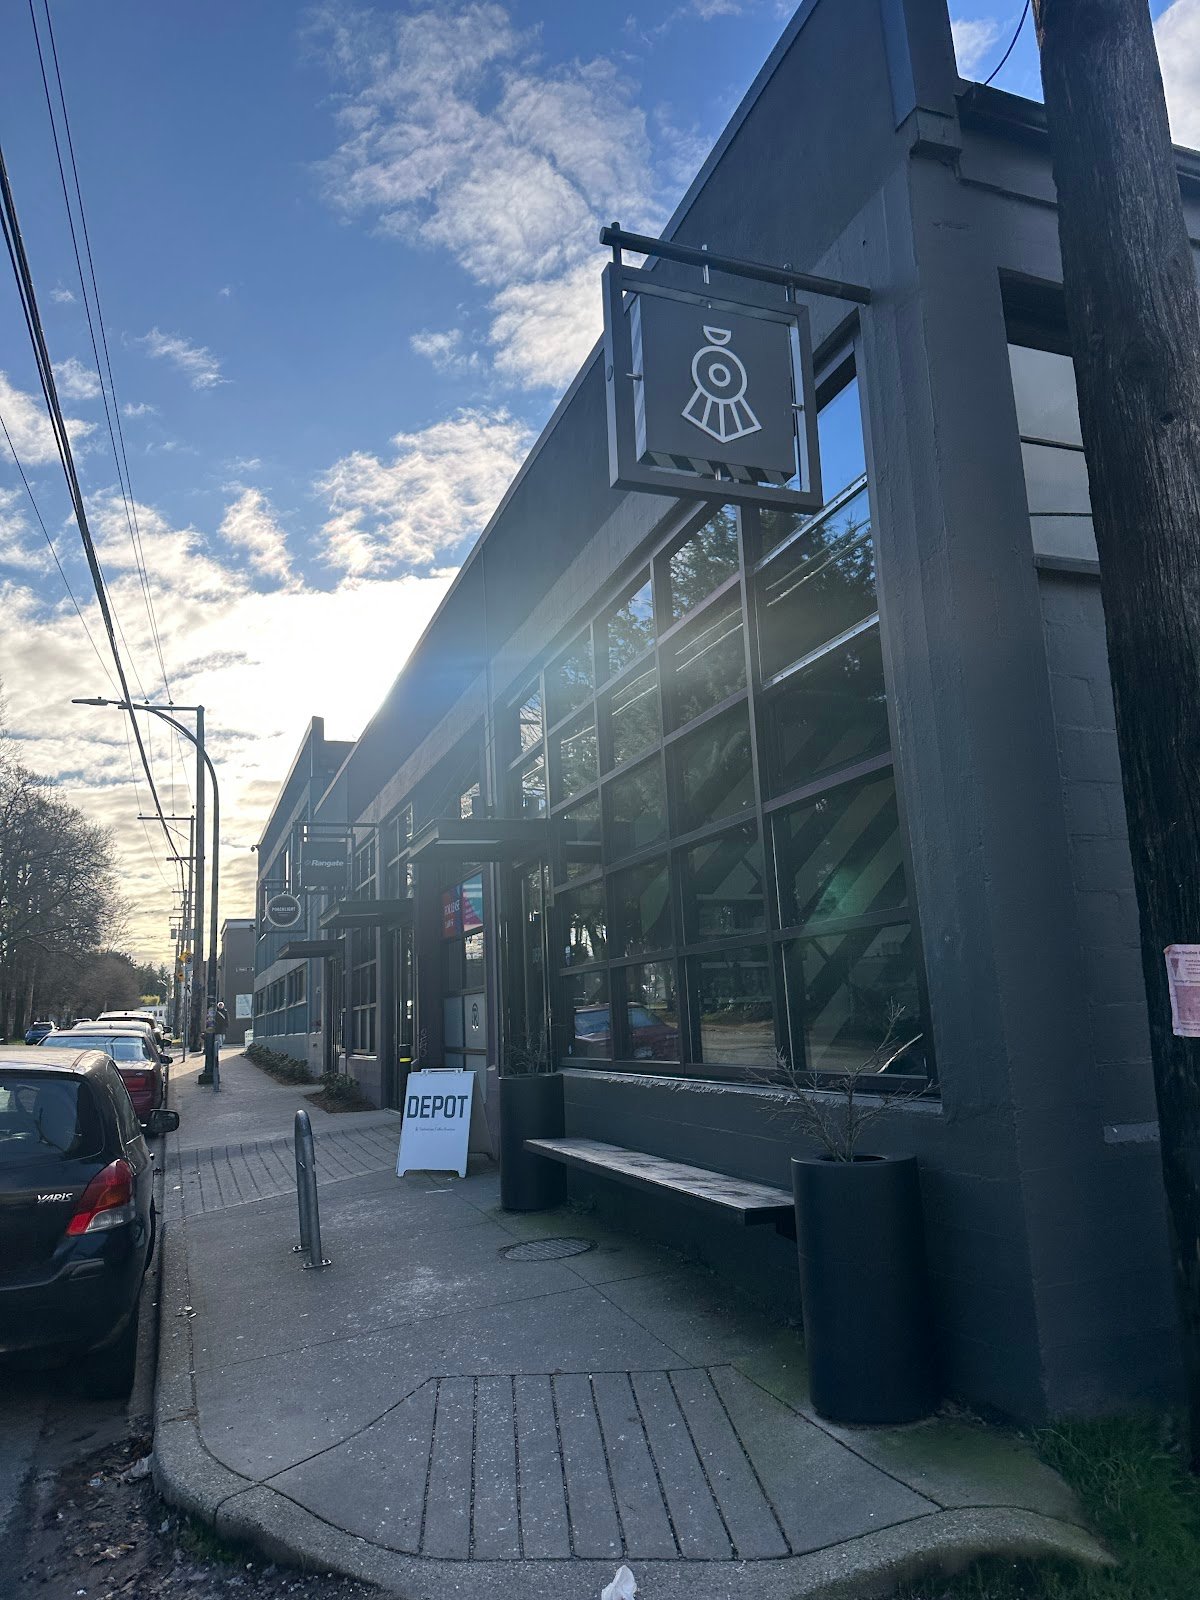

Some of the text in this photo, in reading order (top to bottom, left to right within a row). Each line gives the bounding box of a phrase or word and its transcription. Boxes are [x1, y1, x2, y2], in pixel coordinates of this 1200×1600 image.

[311, 860, 344, 868] Rangate
[406, 1095, 469, 1119] DEPOT
[37, 1193, 73, 1203] YARIS
